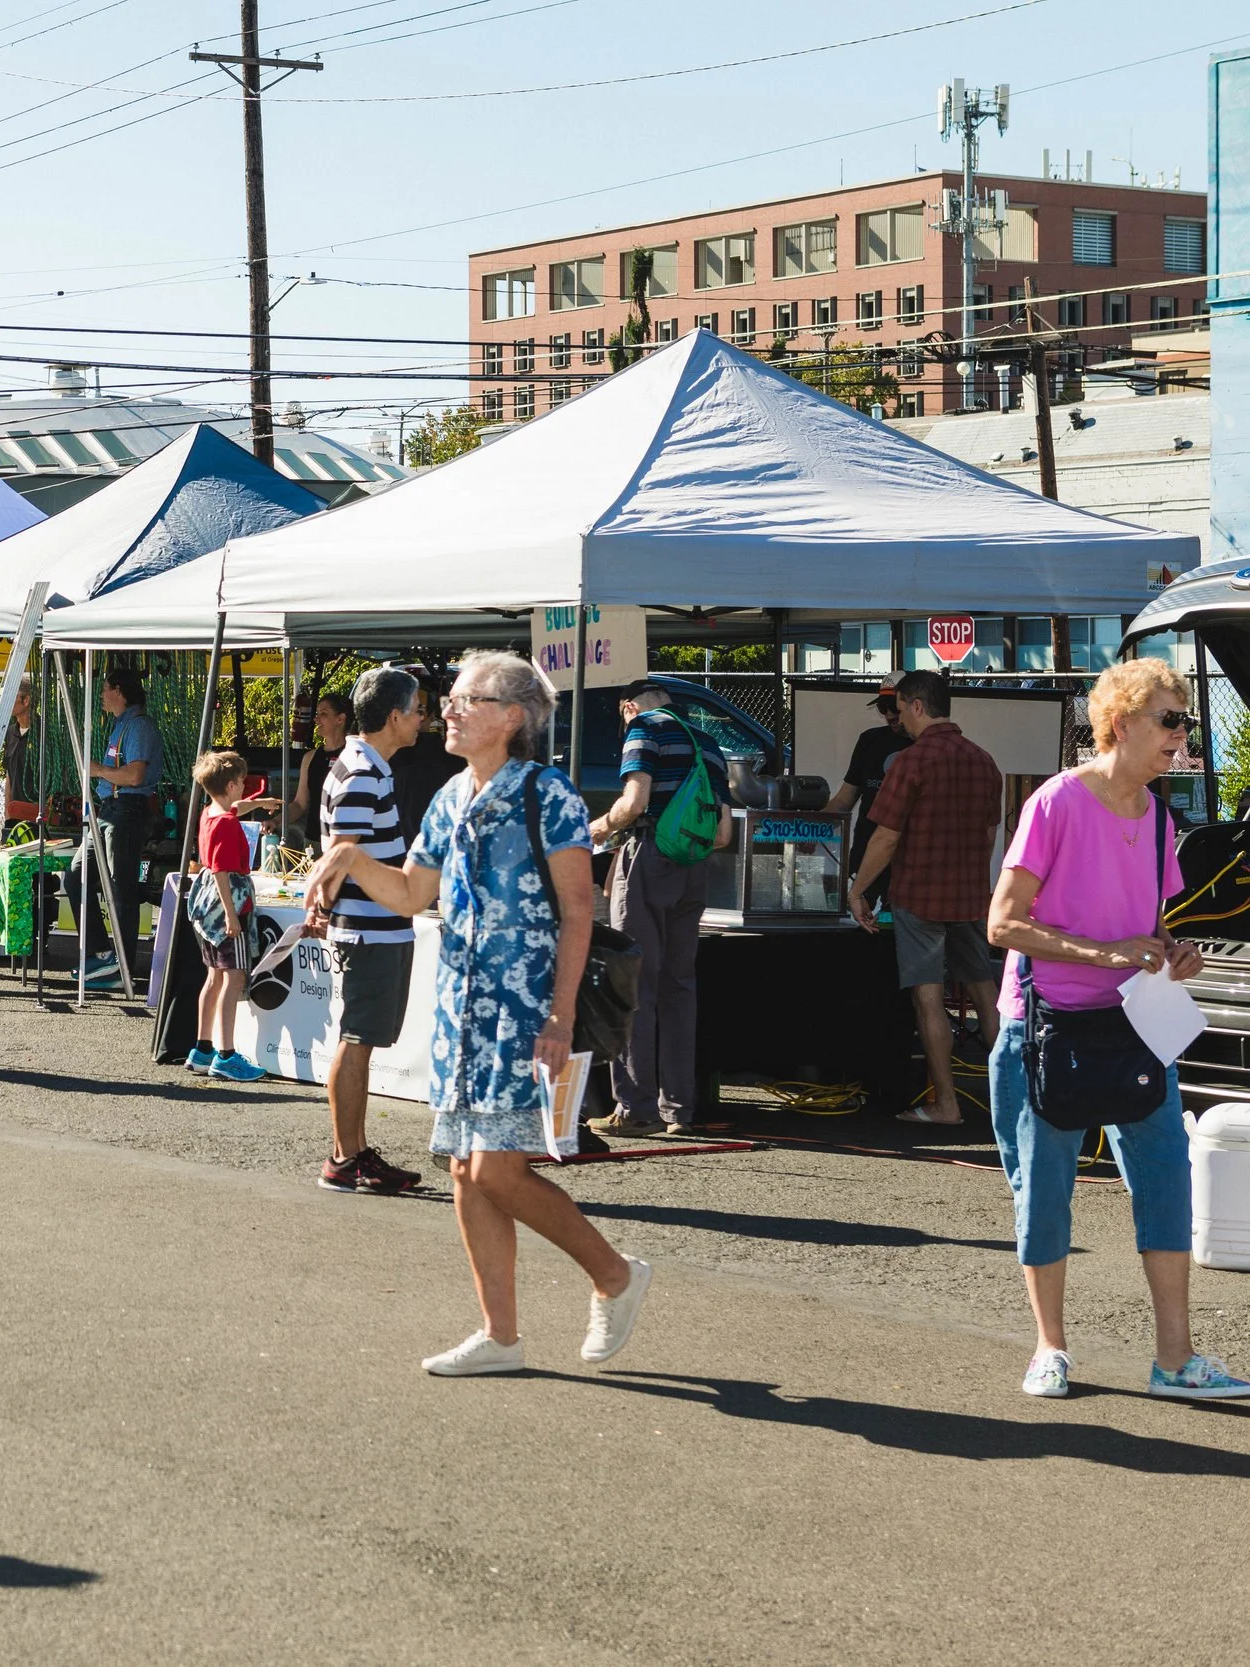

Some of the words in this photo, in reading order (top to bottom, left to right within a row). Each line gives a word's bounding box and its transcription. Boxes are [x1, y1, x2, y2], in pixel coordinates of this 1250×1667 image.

[932, 622, 971, 644] STOP
[539, 639, 611, 674] CHALLNGE
[761, 817, 834, 838] Sno-Kones
[300, 980, 328, 1000] Design
[266, 1043, 291, 1057] Climate
[293, 1047, 311, 1060] Action
[368, 1060, 410, 1077] Environment
